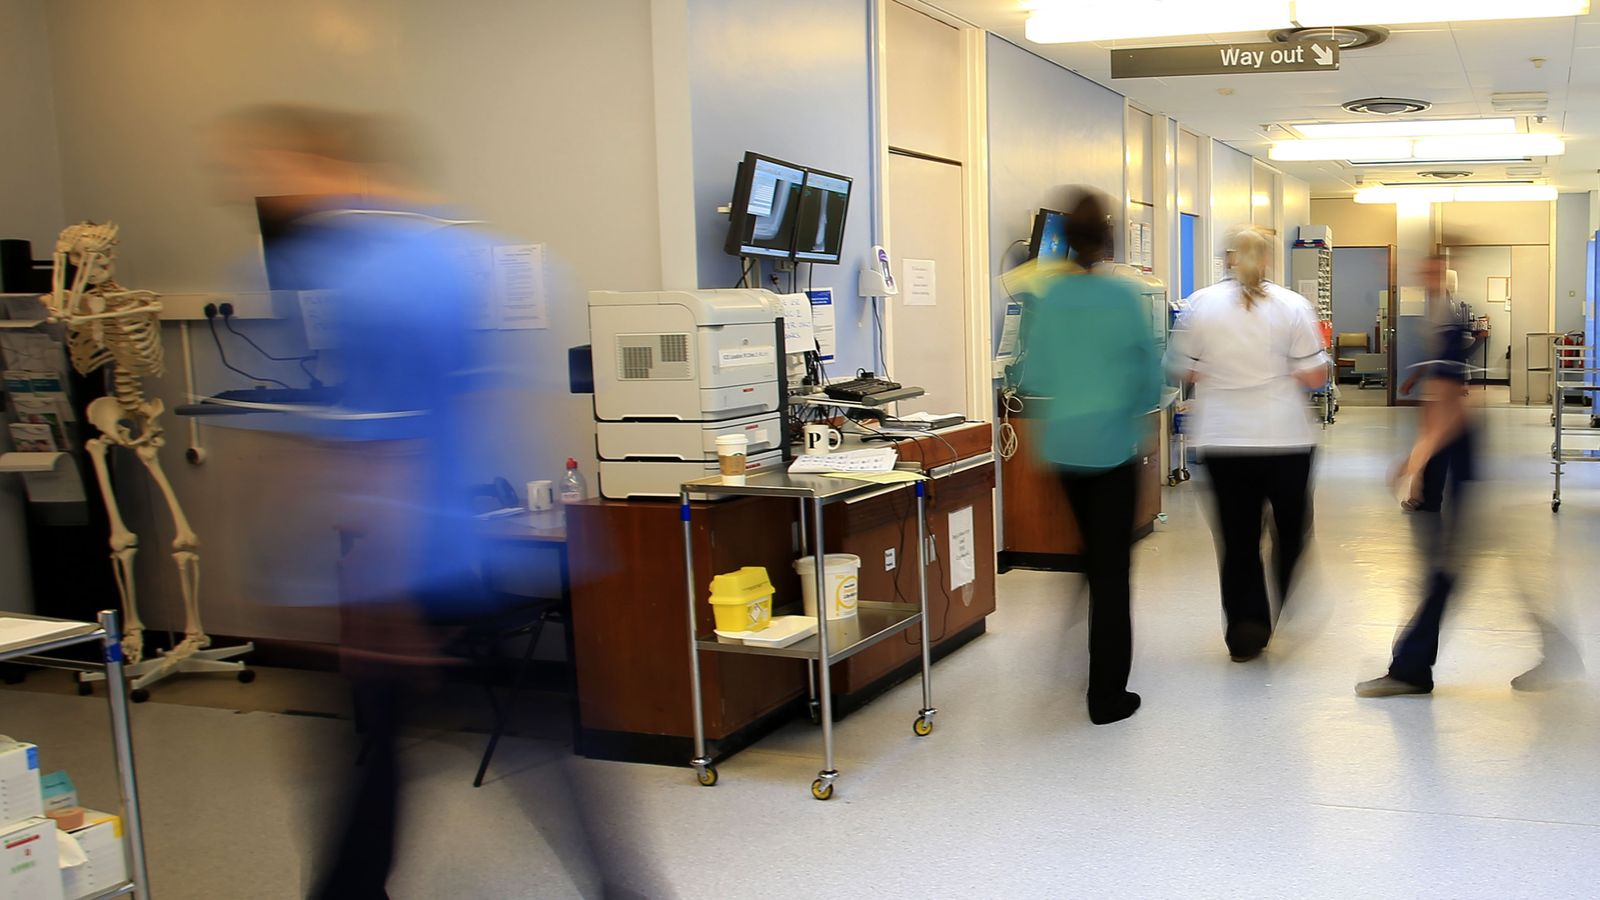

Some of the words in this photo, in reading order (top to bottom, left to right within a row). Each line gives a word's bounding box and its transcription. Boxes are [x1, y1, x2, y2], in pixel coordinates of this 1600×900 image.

[1220, 48, 1264, 69] Way
[1270, 45, 1305, 64] out
[808, 432, 821, 449] P
